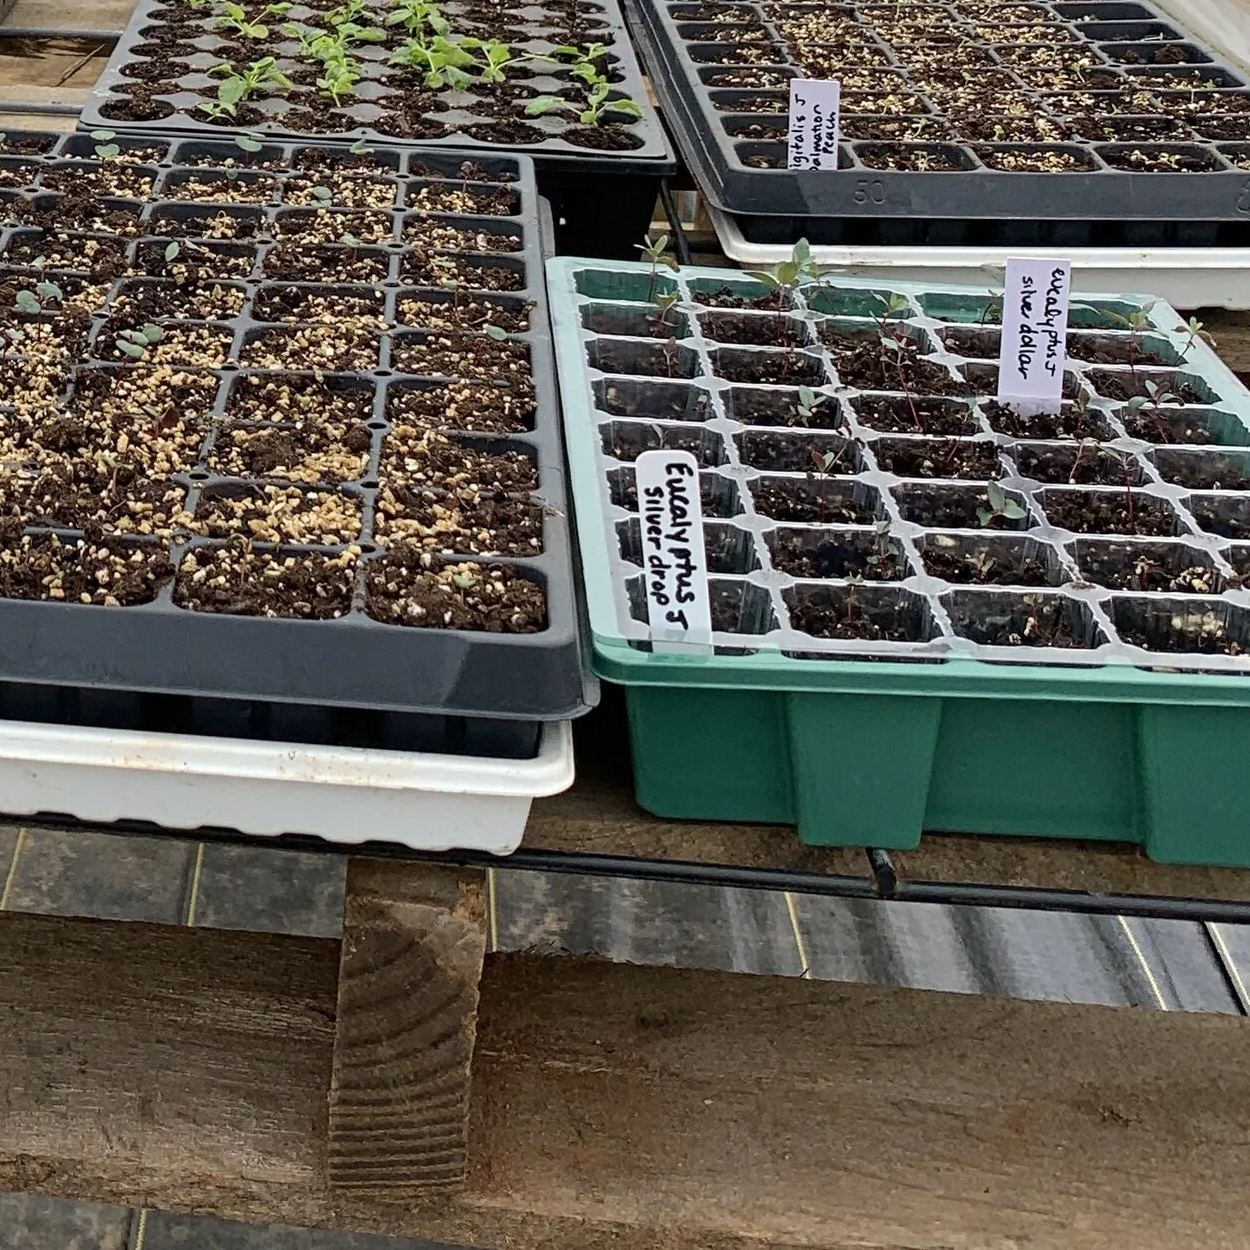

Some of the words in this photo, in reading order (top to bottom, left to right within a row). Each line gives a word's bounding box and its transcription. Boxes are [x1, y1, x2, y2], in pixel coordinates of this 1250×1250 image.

[790, 115, 809, 170] igitalis
[665, 463, 697, 603] Eucalyptus
[648, 555, 671, 606] drop
